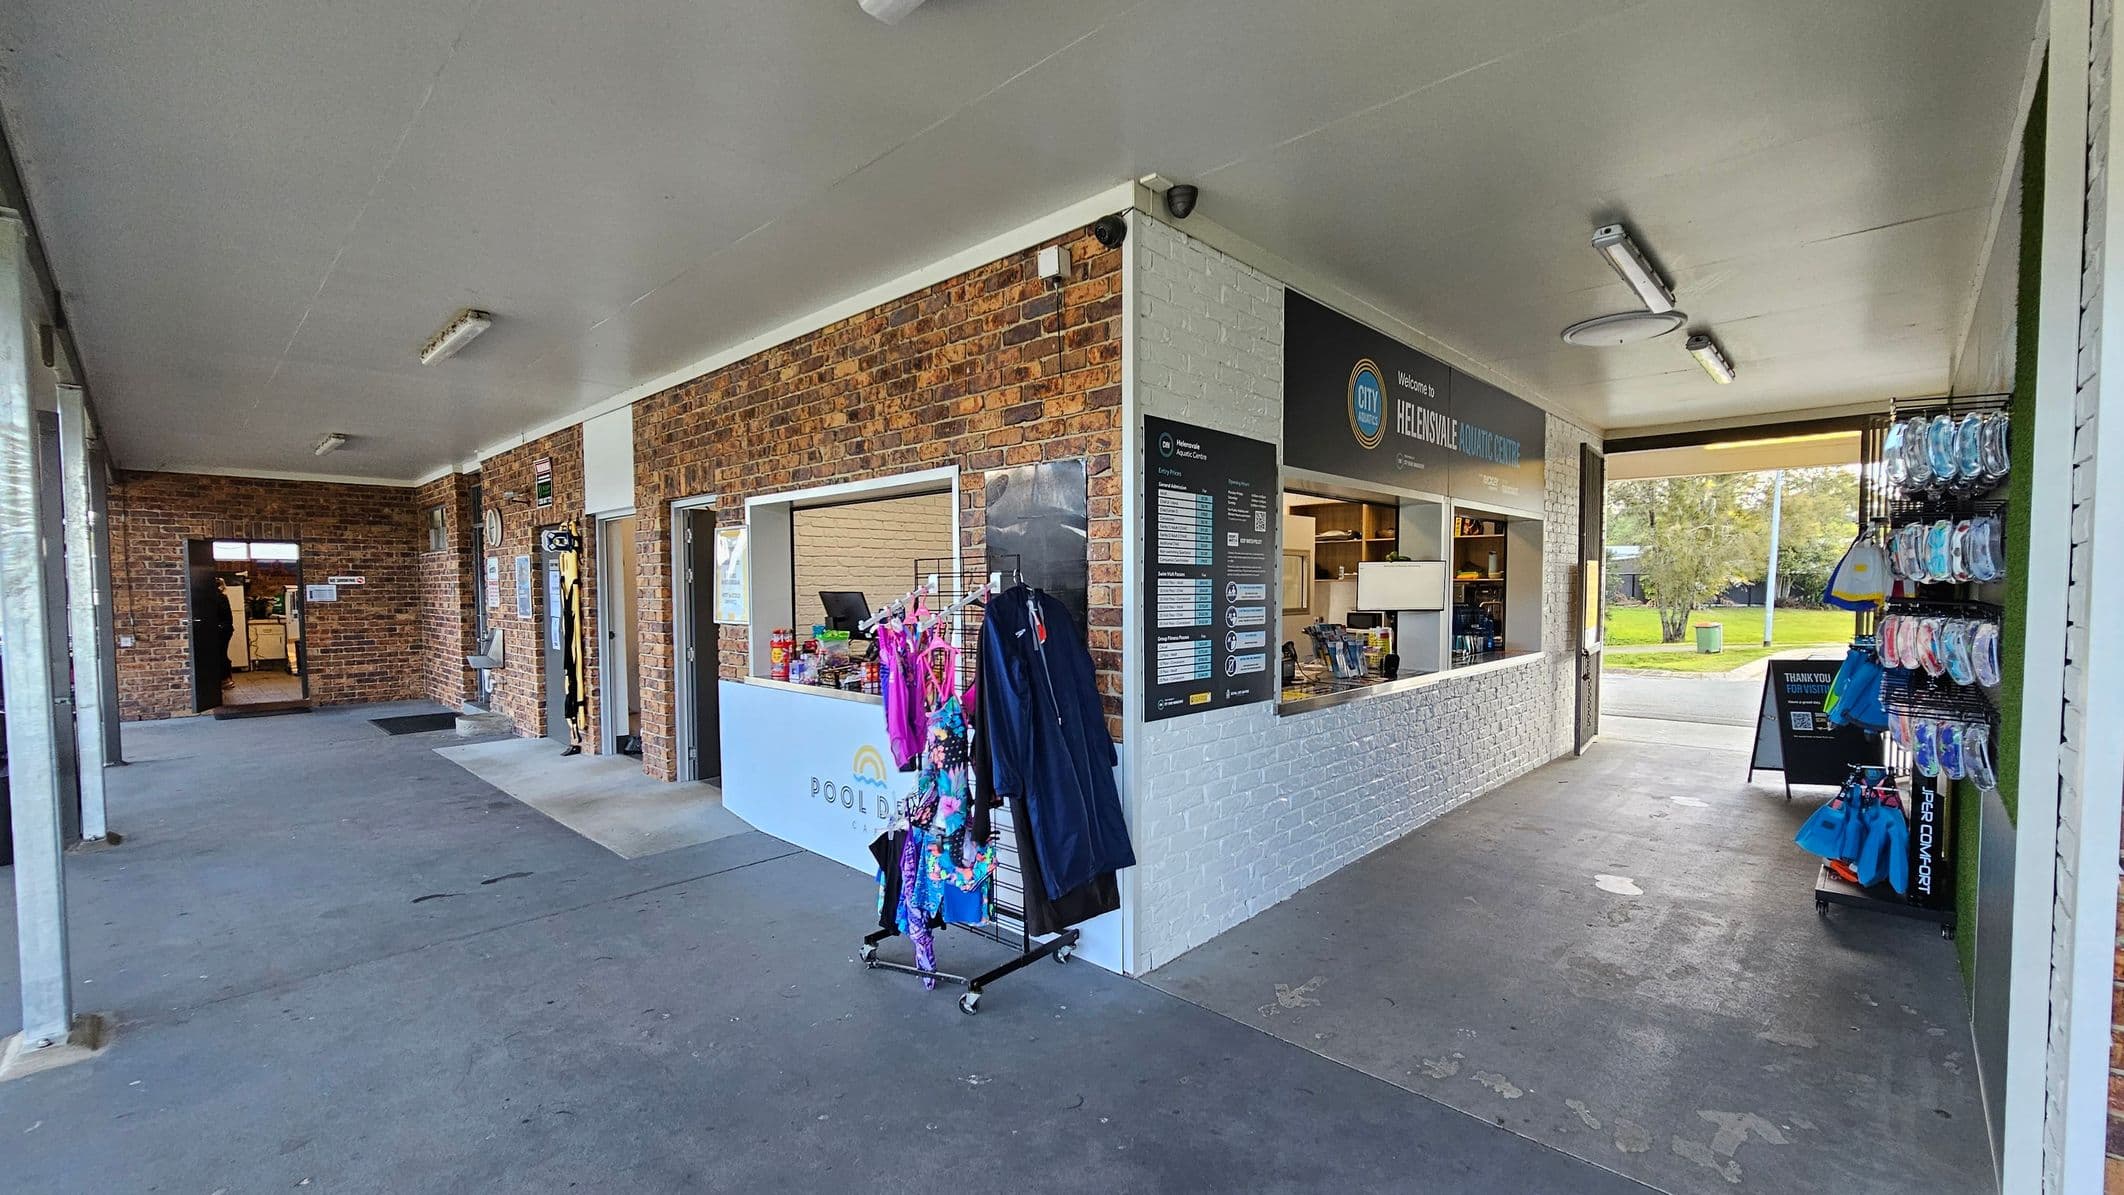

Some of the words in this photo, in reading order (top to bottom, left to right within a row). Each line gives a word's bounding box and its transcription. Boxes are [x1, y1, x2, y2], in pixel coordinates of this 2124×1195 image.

[1397, 370, 1428, 395] Welcome
[1428, 384, 1435, 398] to
[1358, 384, 1379, 413] CITY
[1358, 411, 1379, 426] AQUATICS
[1397, 398, 1458, 451] HELENSVALE
[1458, 422, 1494, 461] AQUATIC
[1494, 434, 1521, 469] CENTRE
[1176, 440, 1200, 450] Helensvale
[1176, 449, 1192, 458] Aquatic
[1193, 452, 1207, 461] Centre
[1158, 467, 1169, 476] Entry
[1784, 672, 1813, 682] THANK
[1814, 673, 1831, 683] YOU
[1787, 684, 1802, 693] FOR
[1803, 684, 1829, 694] VISITI
[810, 776, 867, 814] POOL
[877, 795, 904, 819] DE
[1918, 825, 1932, 895] COMFORT
